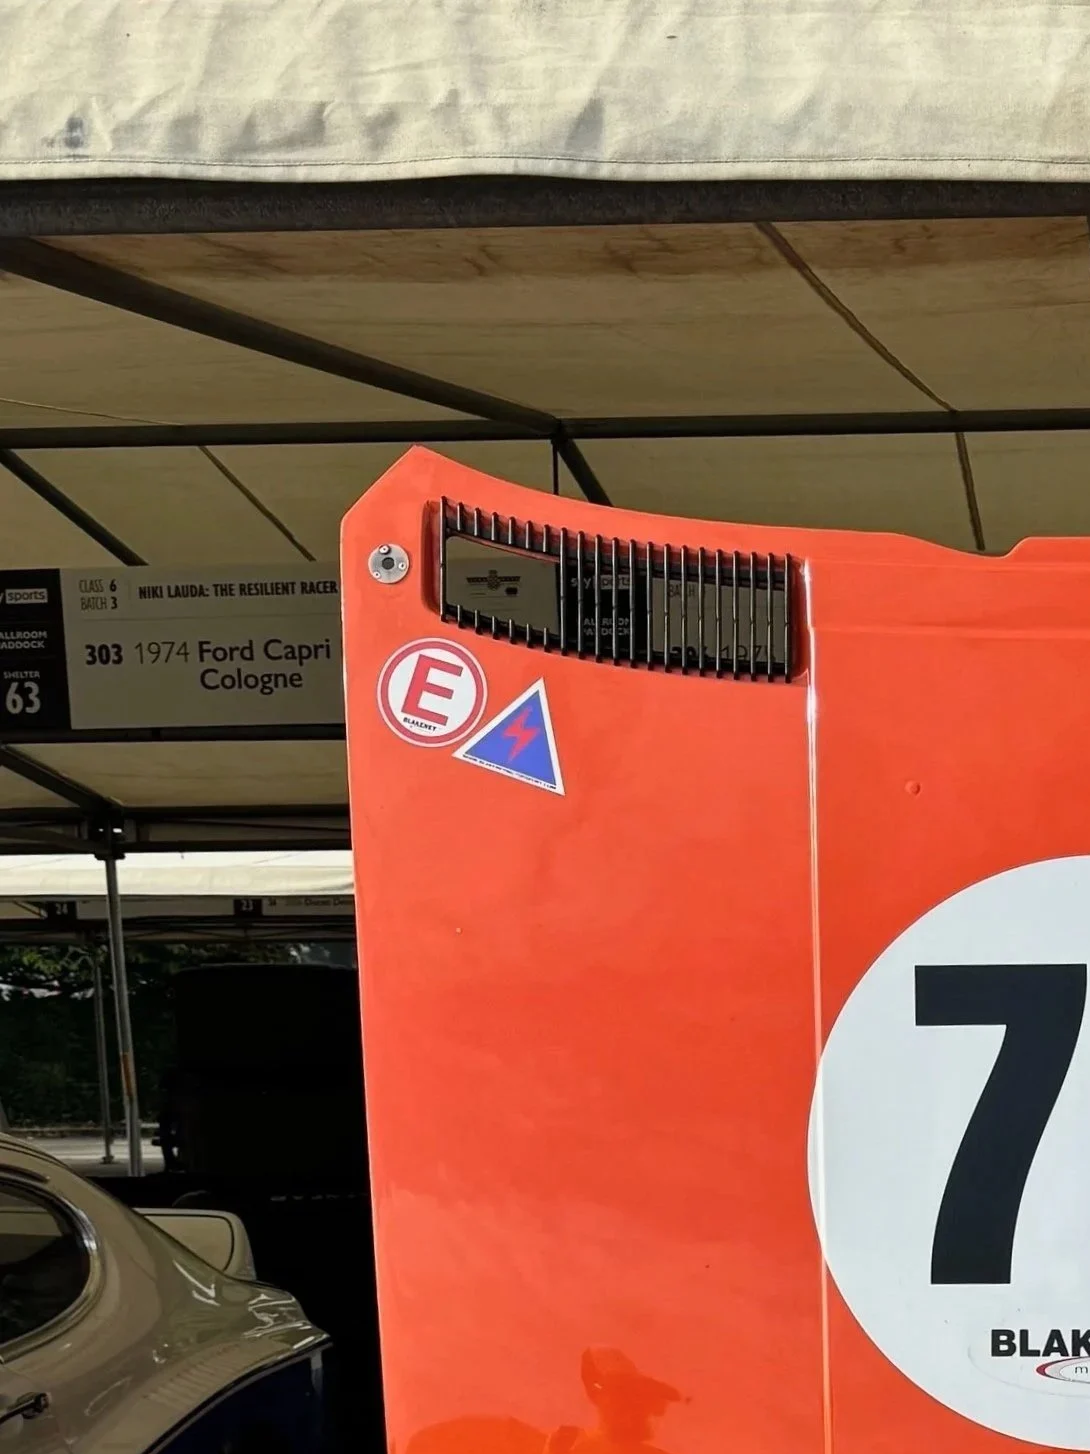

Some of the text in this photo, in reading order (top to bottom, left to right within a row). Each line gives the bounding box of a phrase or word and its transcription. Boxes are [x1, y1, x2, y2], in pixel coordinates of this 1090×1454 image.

[79, 578, 117, 593] CLASS 6
[138, 580, 338, 600] NIKI LAUDA: THE RESILIENT RACER
[7, 590, 46, 602] sports
[81, 596, 118, 611] BATCH 3
[0, 631, 47, 640] ALLROOM
[0, 640, 45, 649] ADDOCK
[85, 639, 331, 666] 303 1974 Ford Capri
[3, 670, 40, 679] SHELTER
[200, 668, 303, 695] Cologne
[6, 681, 41, 714] 63
[401, 654, 463, 726] E
